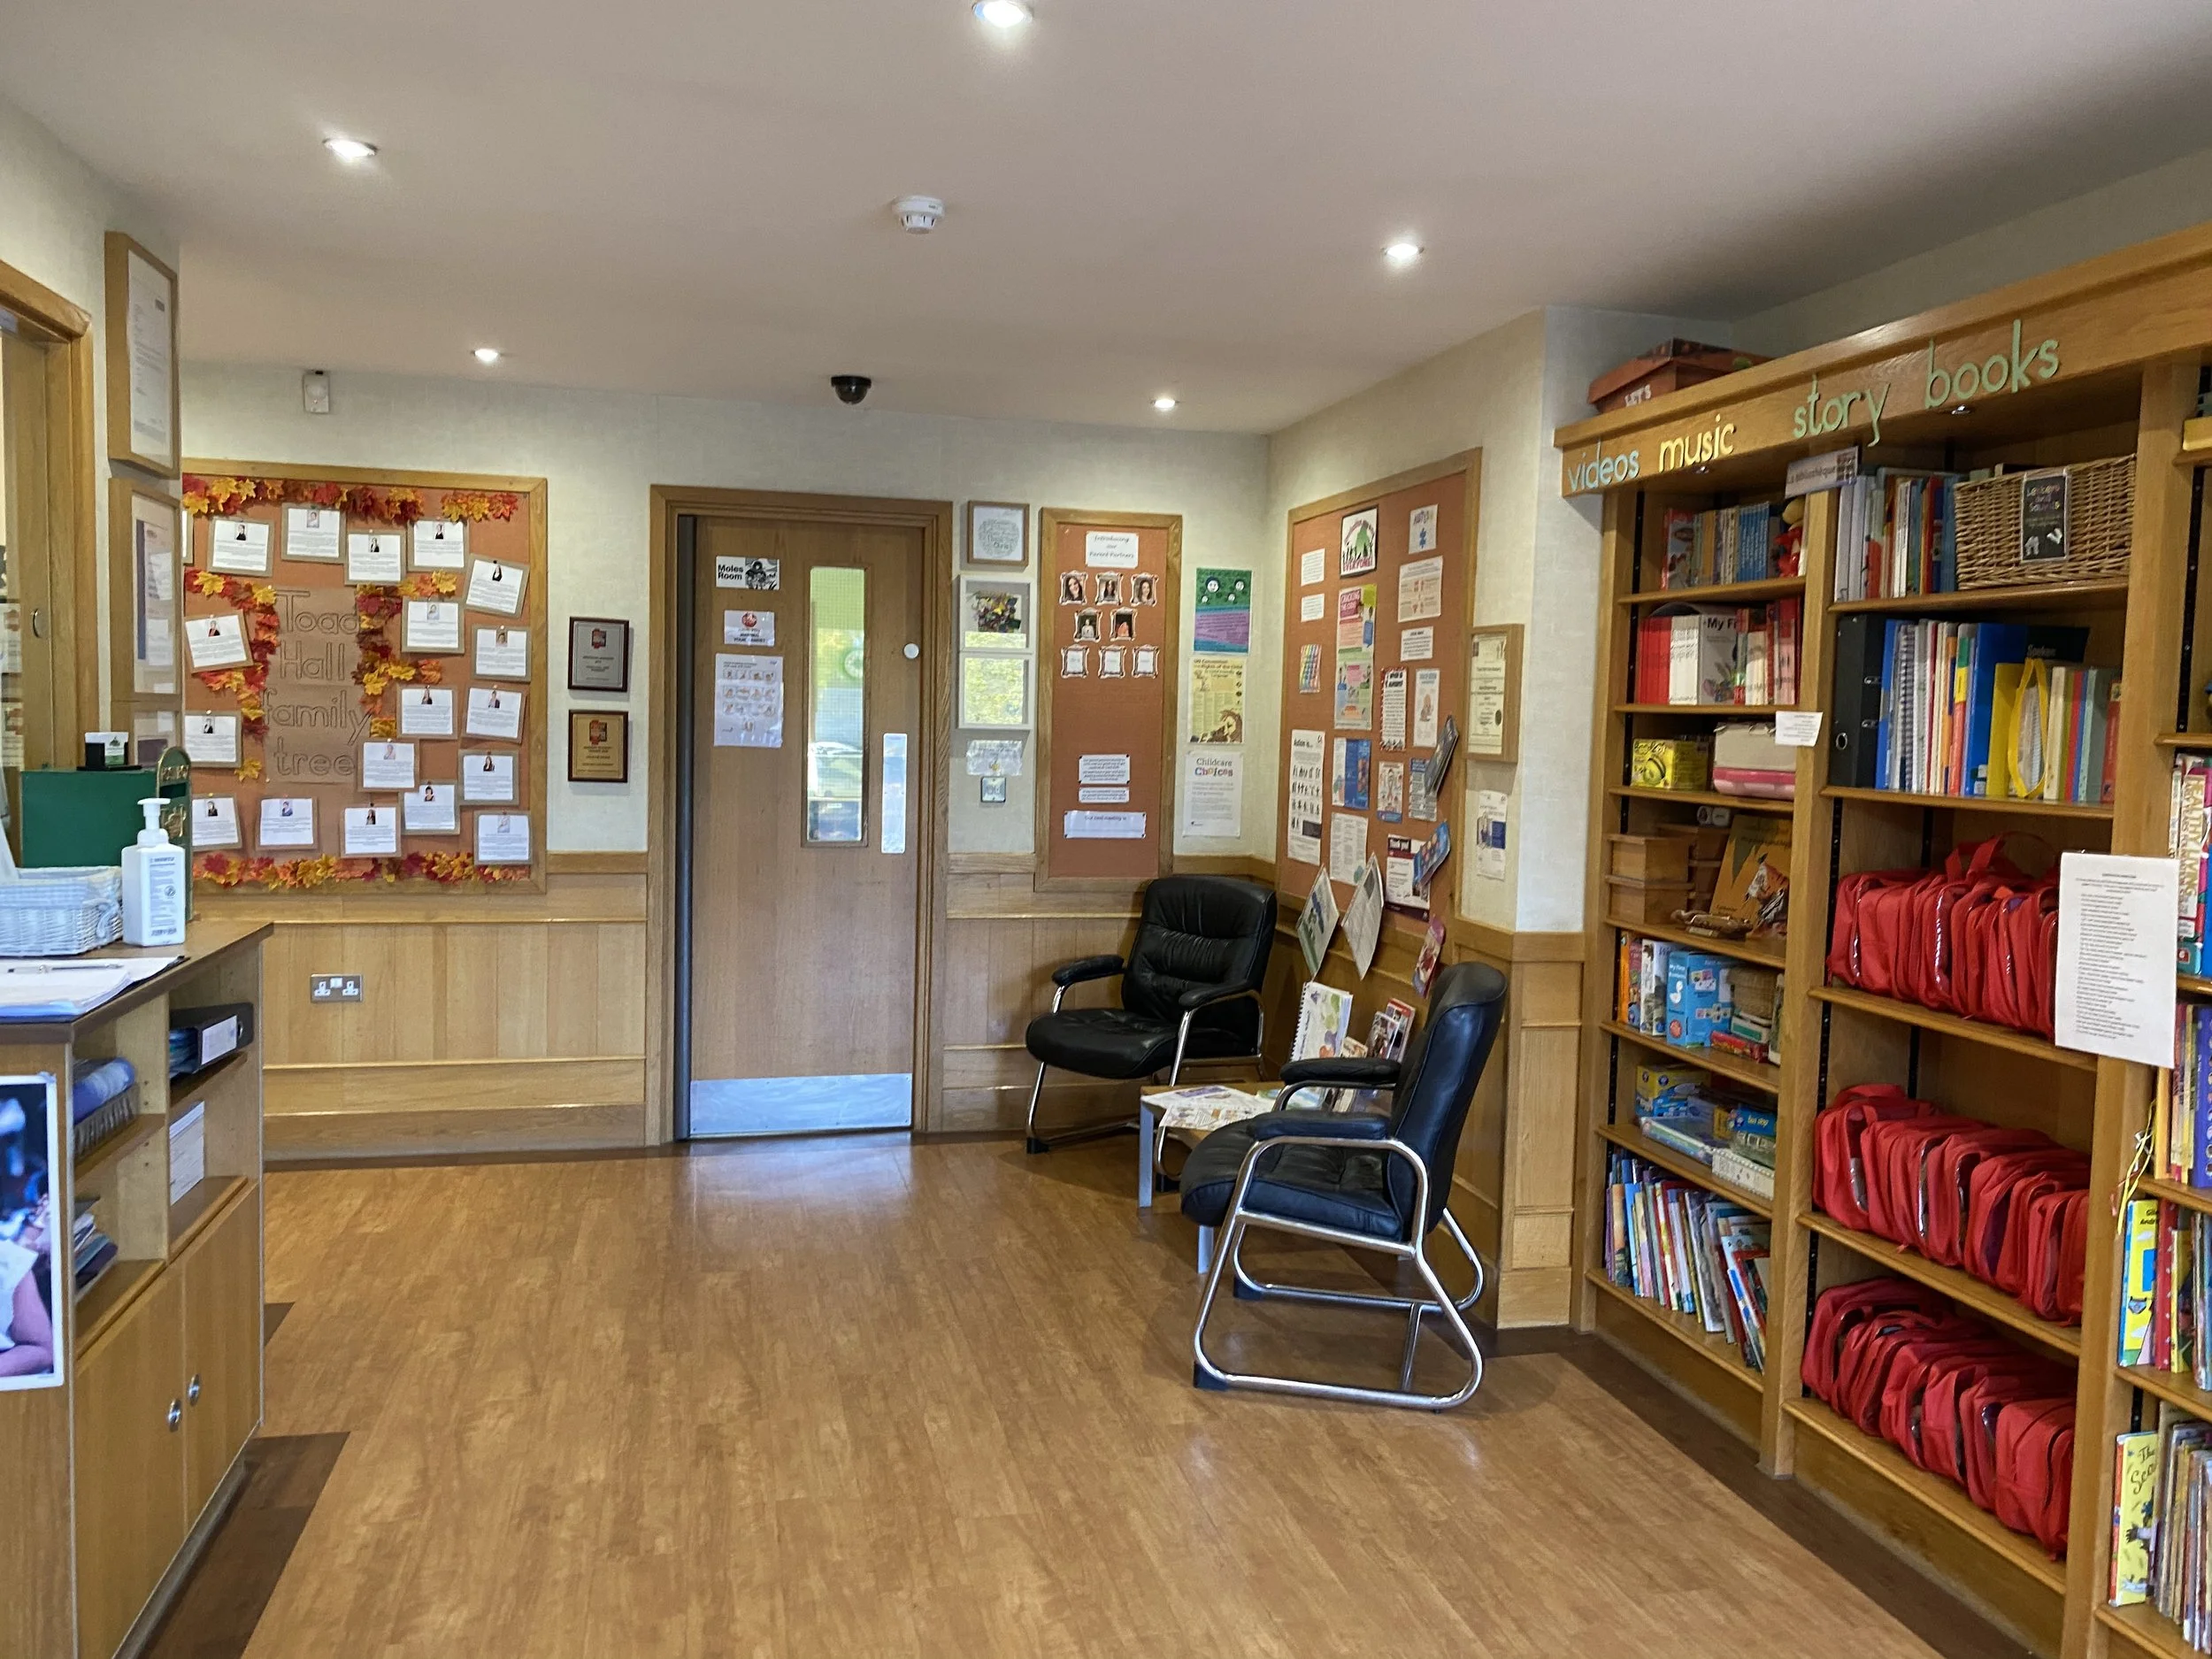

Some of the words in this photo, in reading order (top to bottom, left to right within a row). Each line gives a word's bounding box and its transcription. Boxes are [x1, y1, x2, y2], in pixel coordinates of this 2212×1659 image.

[1792, 373, 1891, 447] story
[1924, 319, 2059, 409] books
[1659, 413, 1736, 472] music
[1568, 438, 1640, 492] videos
[718, 572, 742, 580] Room
[275, 589, 360, 634] Toad
[1707, 618, 1724, 631] My
[280, 640, 345, 680] Hall
[263, 686, 372, 746] family
[273, 736, 355, 776] tree
[1194, 766, 1233, 777] Choices
[1196, 757, 1233, 766] Childcare
